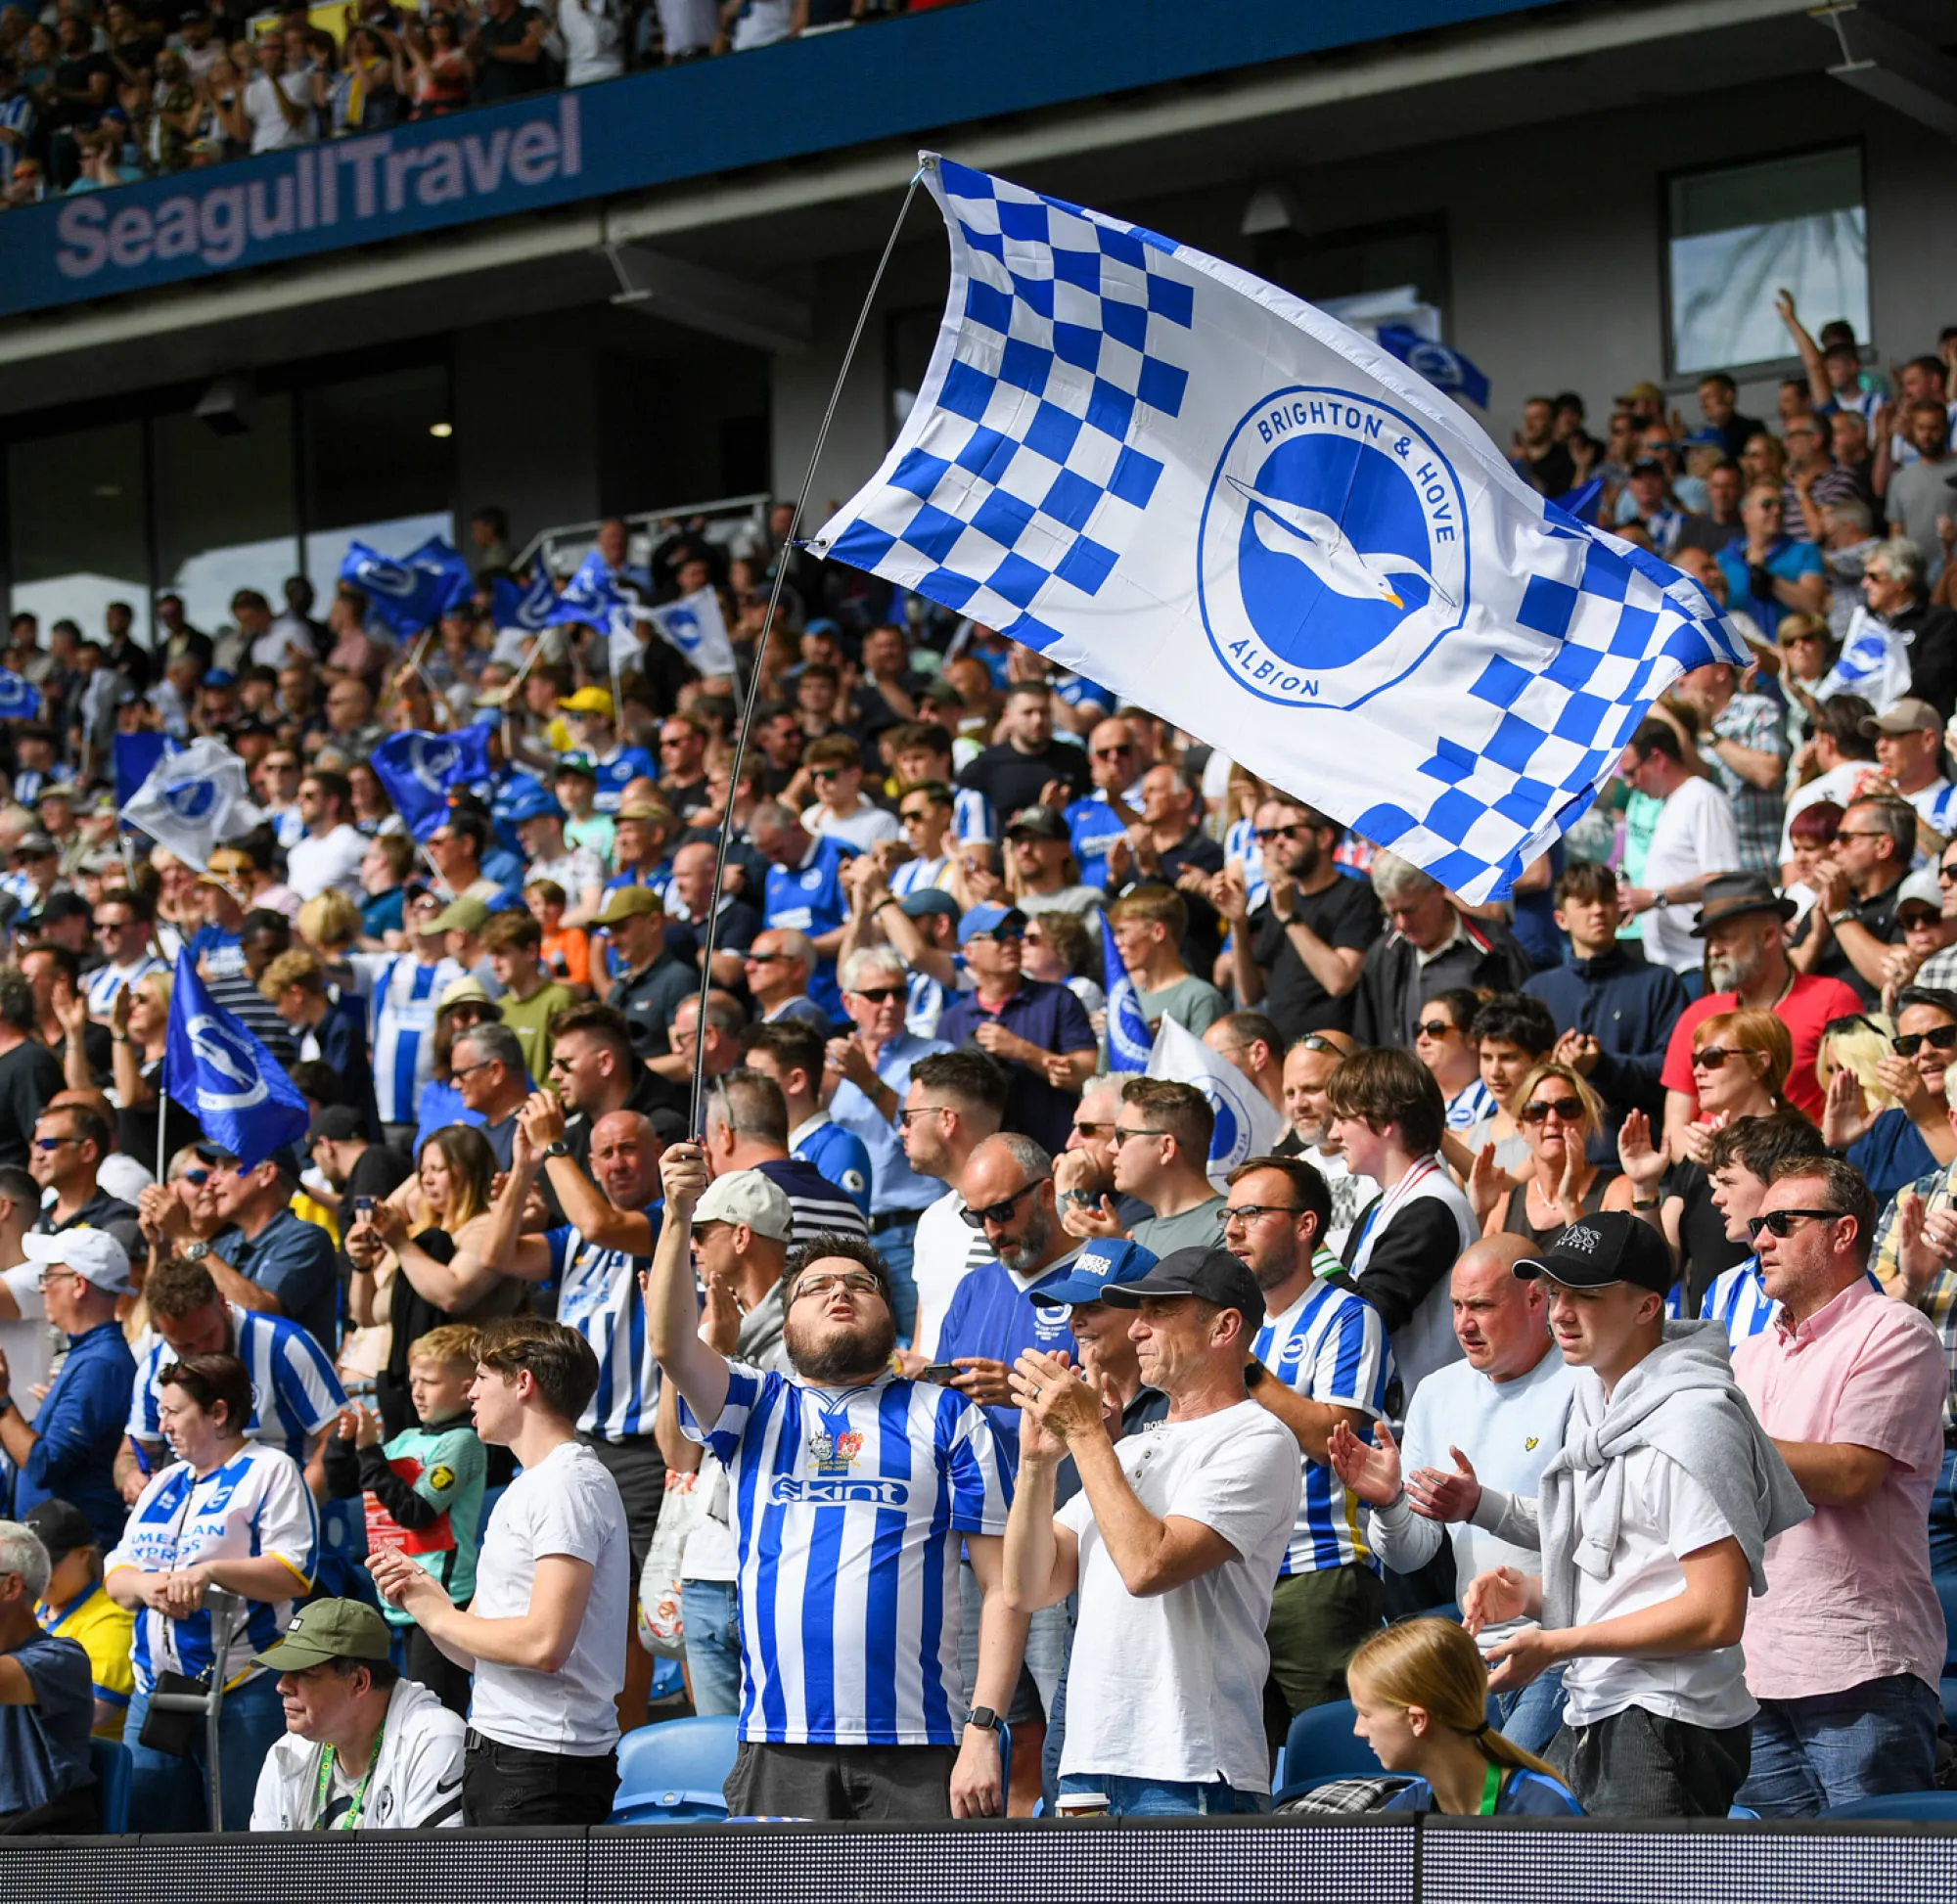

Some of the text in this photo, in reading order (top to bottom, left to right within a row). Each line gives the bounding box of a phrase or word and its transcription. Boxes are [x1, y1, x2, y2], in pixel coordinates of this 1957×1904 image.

[1257, 401, 1455, 544] BRIGHTON & HOVE
[1228, 638, 1320, 698] ALBION
[1563, 1223, 1602, 1249] OSS
[778, 1479, 900, 1505] Skint
[131, 1524, 225, 1547] MEAN
[134, 1538, 201, 1562] XPRS
